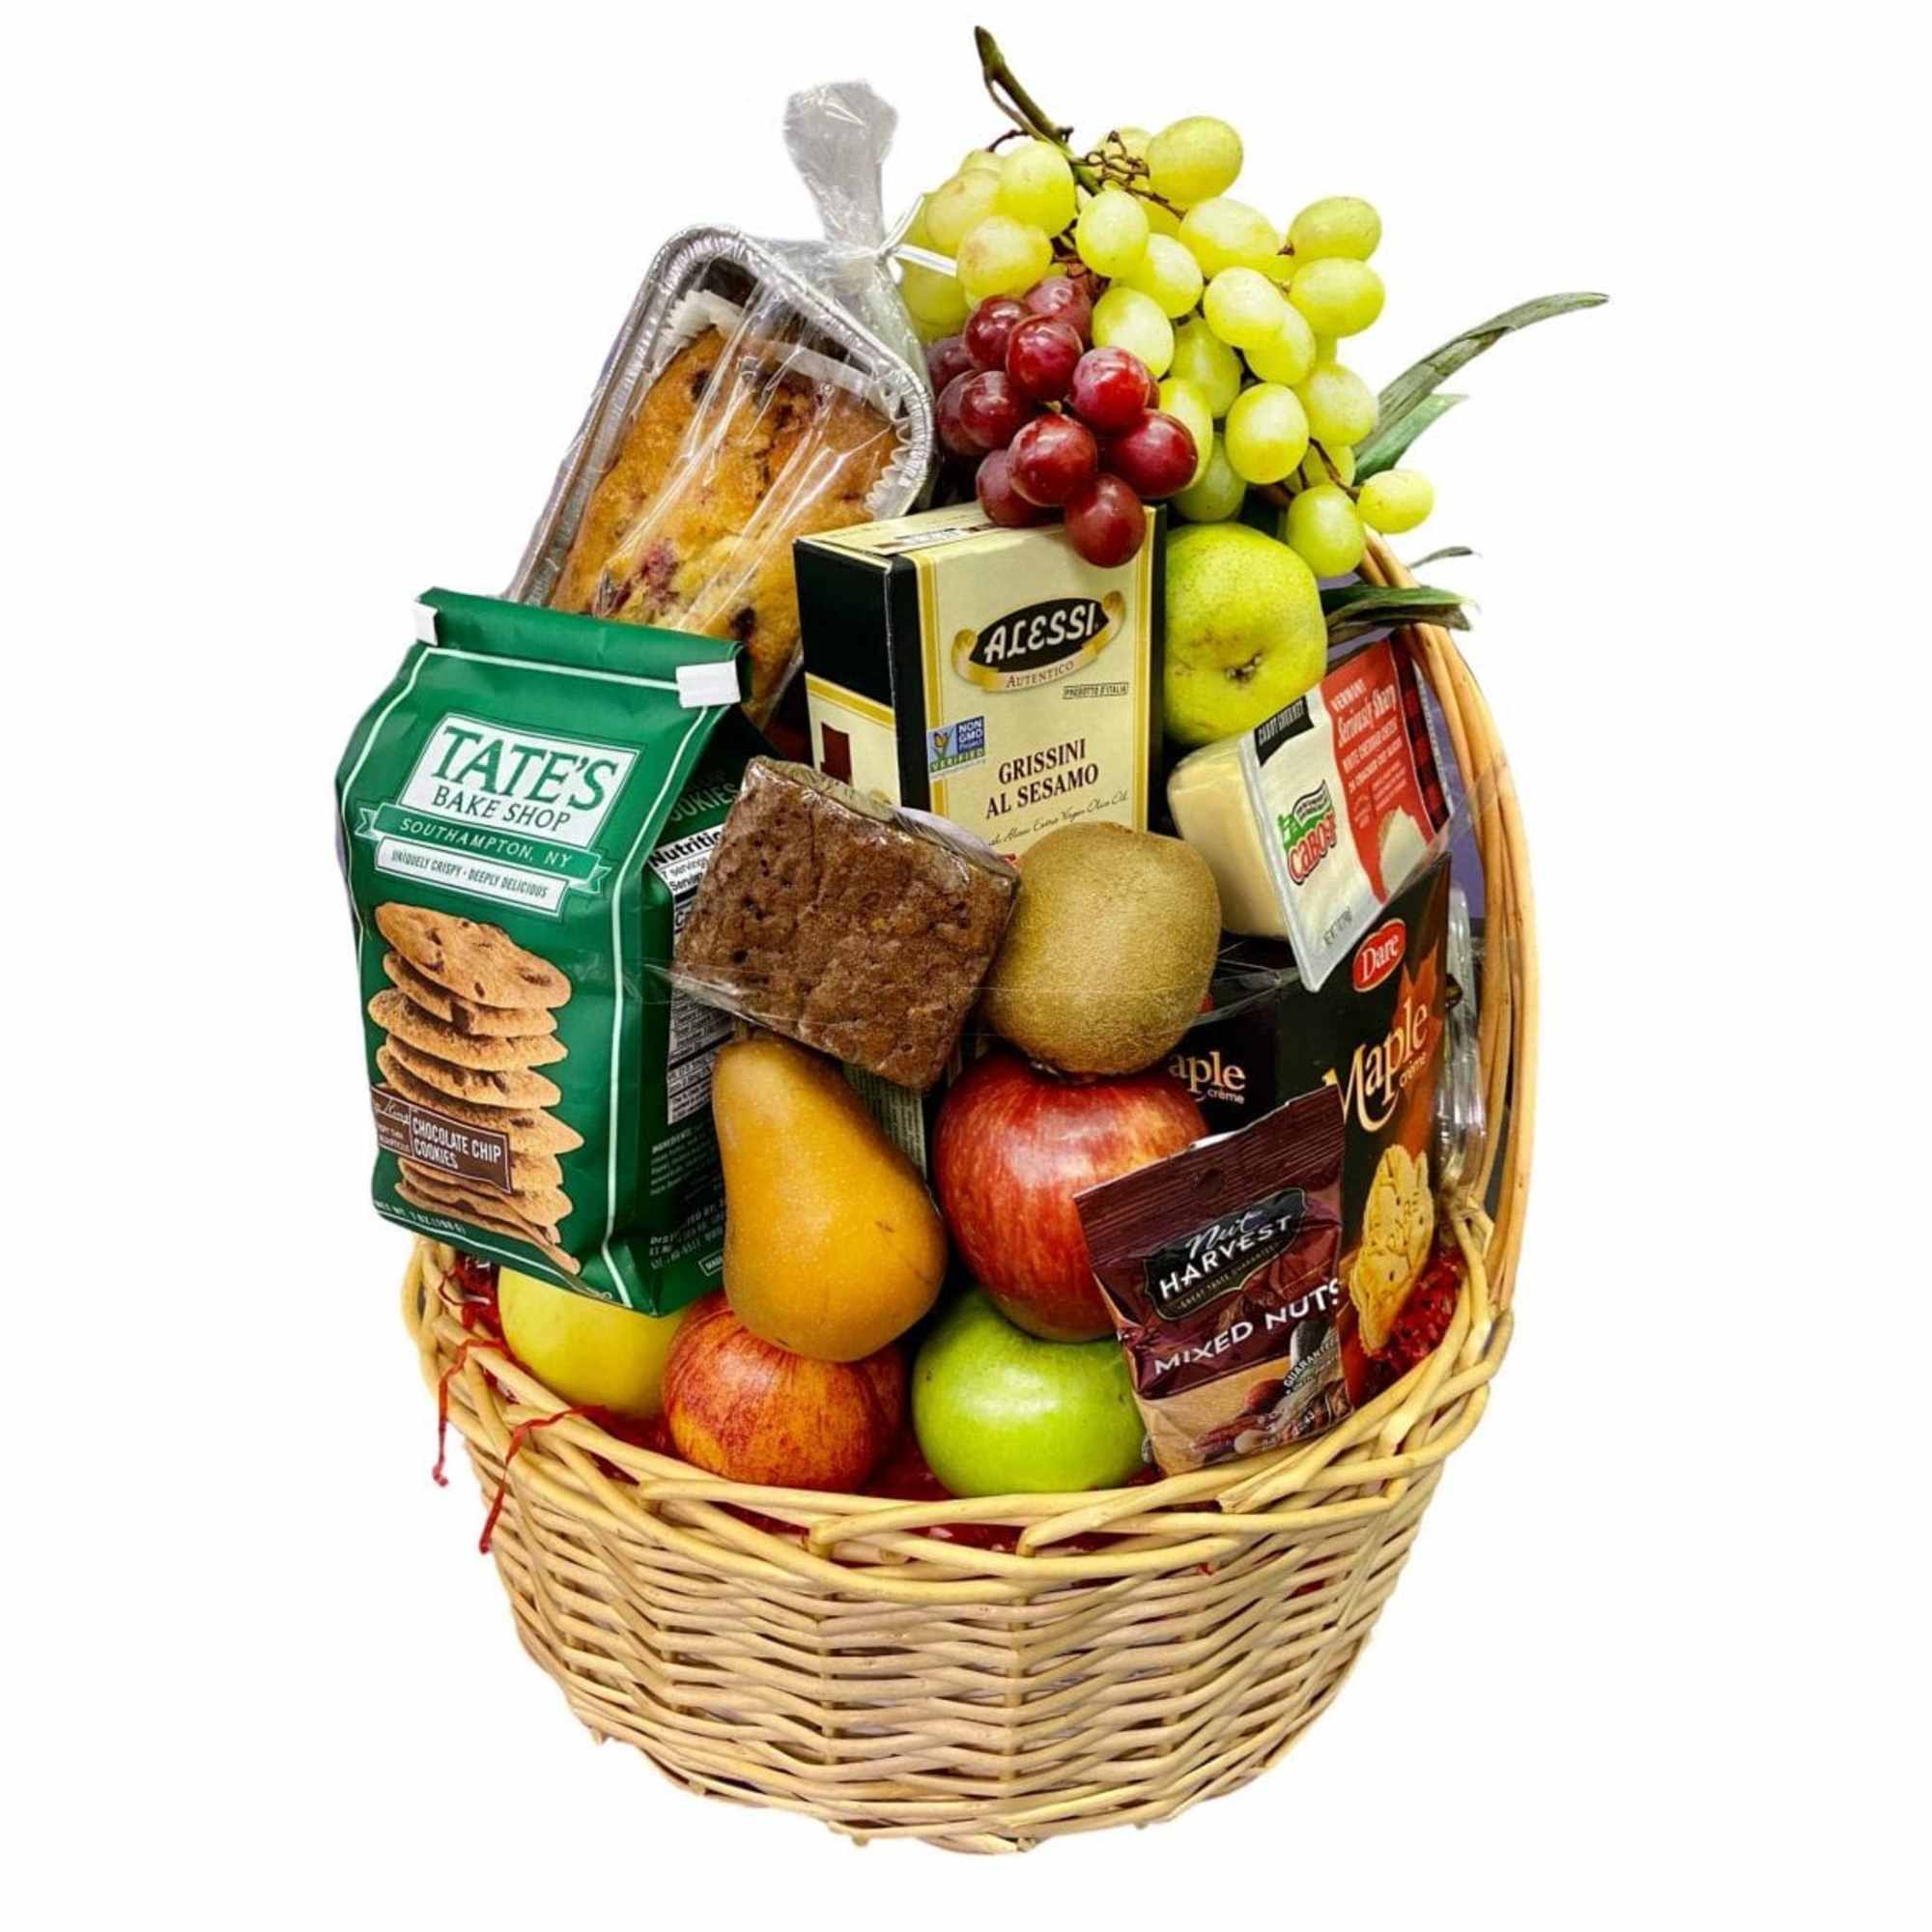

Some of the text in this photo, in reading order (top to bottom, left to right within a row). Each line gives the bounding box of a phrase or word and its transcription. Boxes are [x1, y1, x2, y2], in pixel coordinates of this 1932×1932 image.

[983, 603, 1096, 664] ALESSI
[1006, 660, 1074, 689] AUTENTICO
[958, 719, 981, 734] NON
[958, 728, 983, 743] GMO
[432, 725, 618, 811] TATE'S
[998, 738, 1086, 785] GRISSINI
[433, 784, 571, 832] BAKE SHOP
[985, 791, 1011, 819] AL
[1017, 762, 1099, 809] SESAMO
[390, 849, 550, 899] UNIQUELY CRISPY DEEPLY DELICIOUS
[543, 850, 573, 868] NY
[1362, 934, 1399, 983] Dare
[1167, 1051, 1246, 1094] aple
[1322, 996, 1428, 1131] Maple
[412, 1117, 469, 1156] CHOCOLATE
[470, 1139, 501, 1163] CHIP
[413, 1137, 459, 1169] COOKIES
[1159, 1215, 1292, 1299] HARVEST
[1184, 1210, 1263, 1260] Nut
[1154, 1321, 1254, 1375] MIXED
[1264, 1278, 1339, 1330] NUTS
